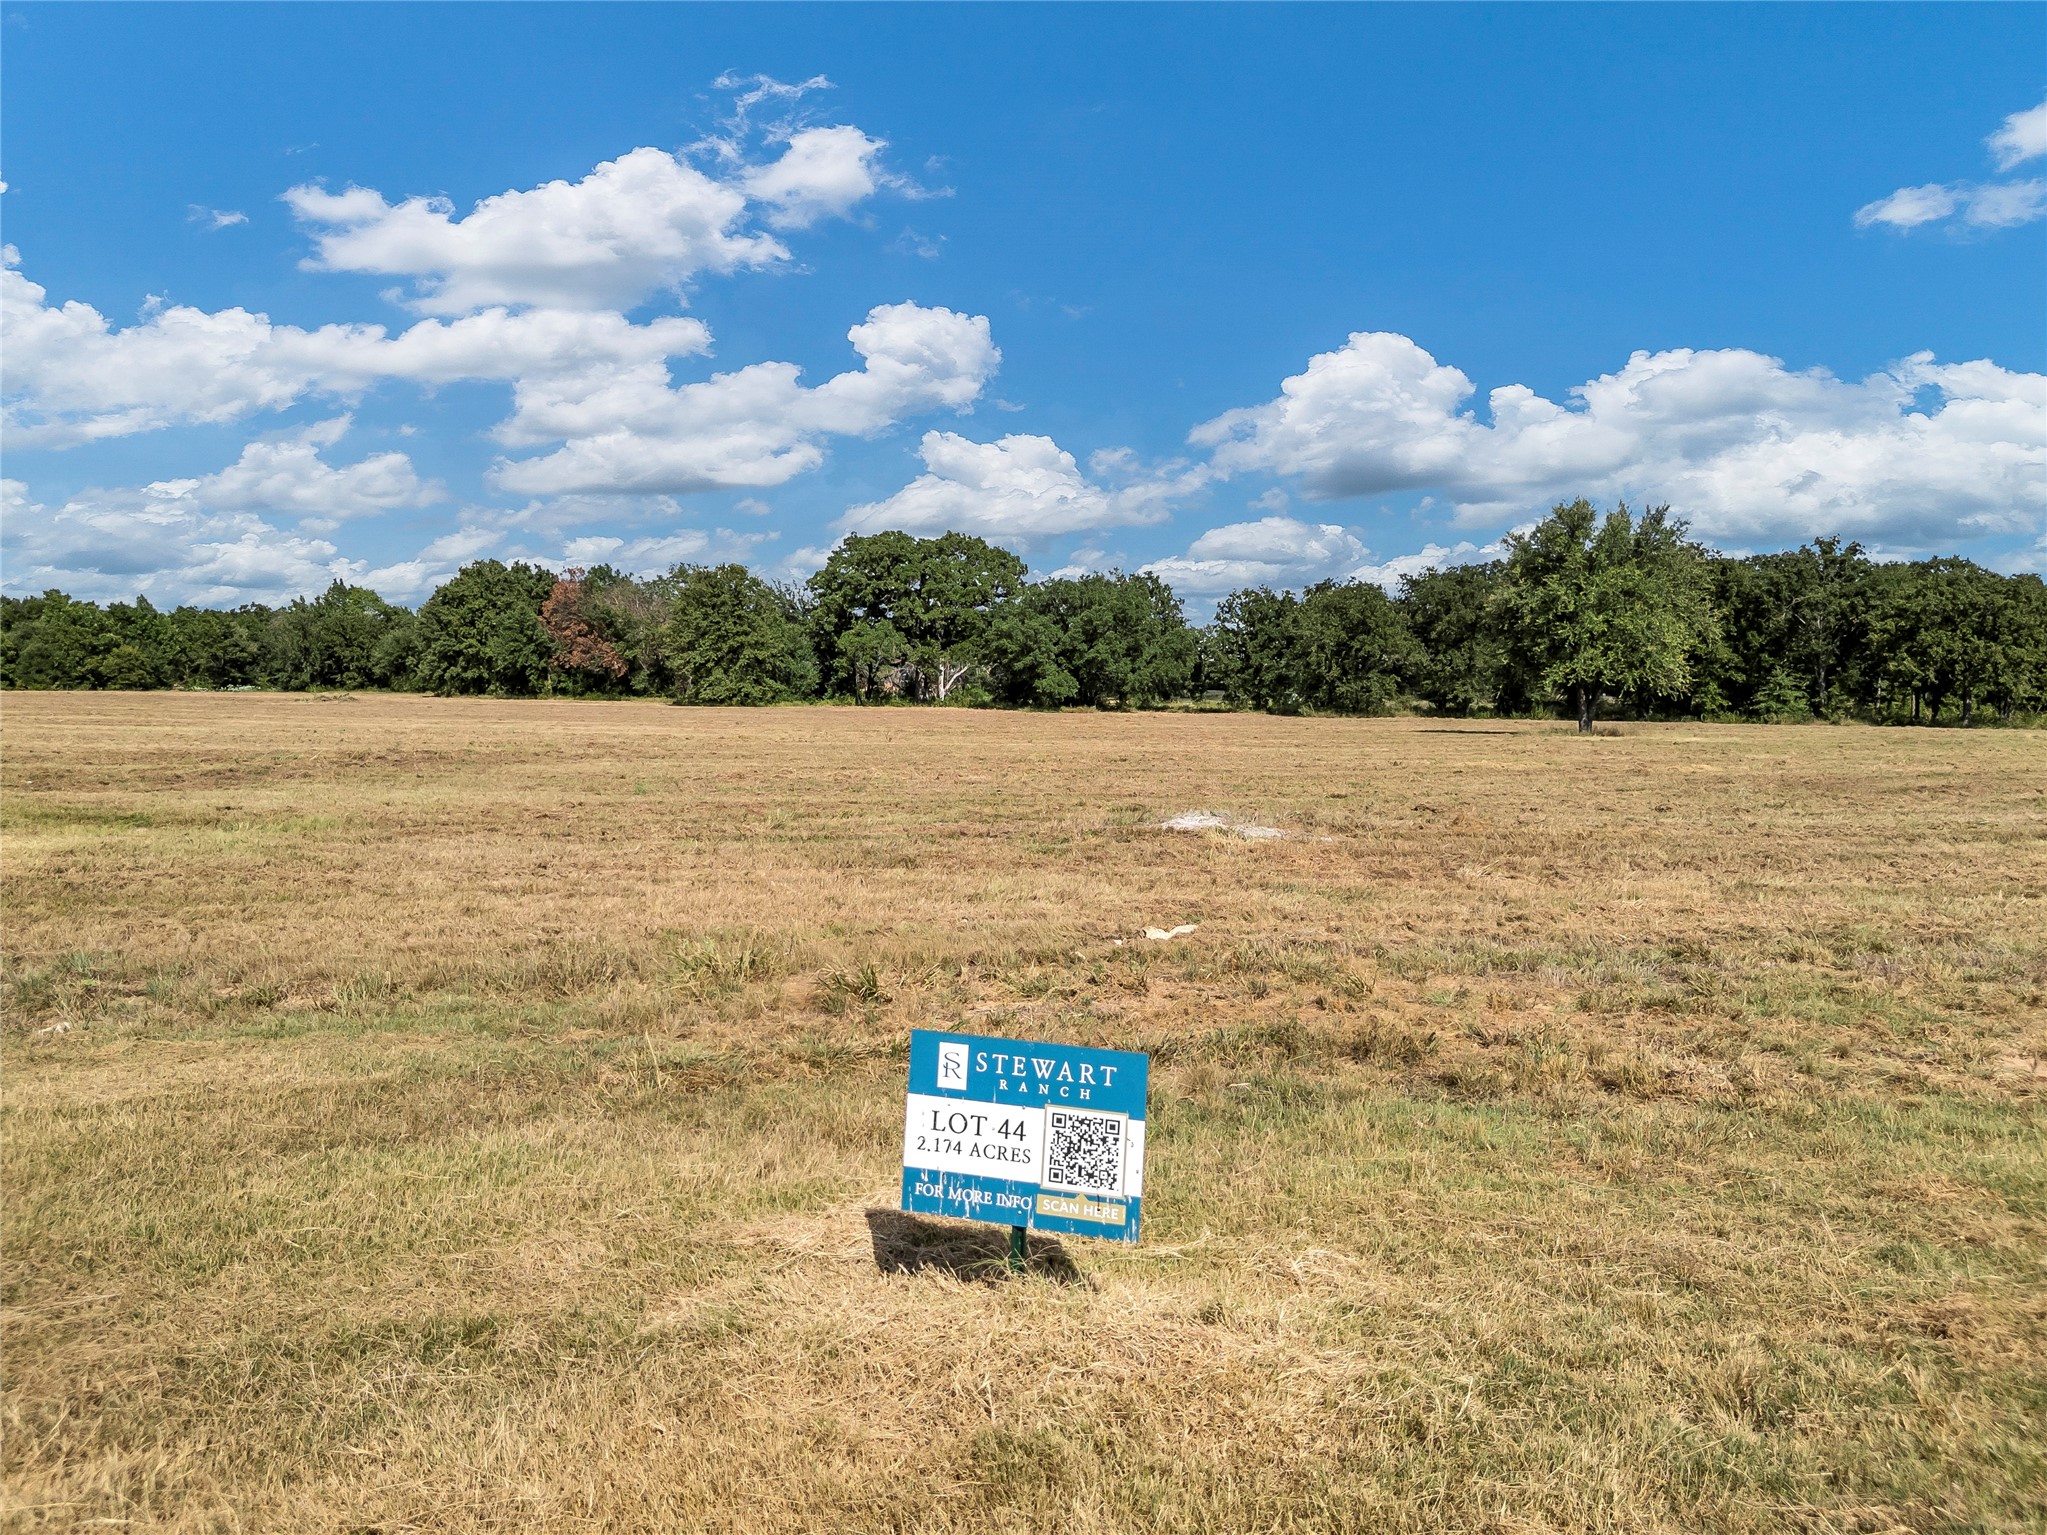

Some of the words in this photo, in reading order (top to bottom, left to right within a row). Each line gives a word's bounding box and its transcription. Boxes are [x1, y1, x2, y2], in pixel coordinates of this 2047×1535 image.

[975, 1052, 1118, 1086] STEWART
[999, 1079, 1090, 1100] RANCH
[931, 1110, 988, 1136] LOT
[998, 1119, 1027, 1141] 44
[917, 1136, 963, 1155] 2.174
[969, 1142, 1031, 1164] ACRES
[914, 1182, 943, 1198] FOR
[948, 1186, 993, 1204] MORE
[996, 1194, 1032, 1210] INFO
[1043, 1199, 1079, 1215] SCAN
[1083, 1203, 1119, 1220] HERE
